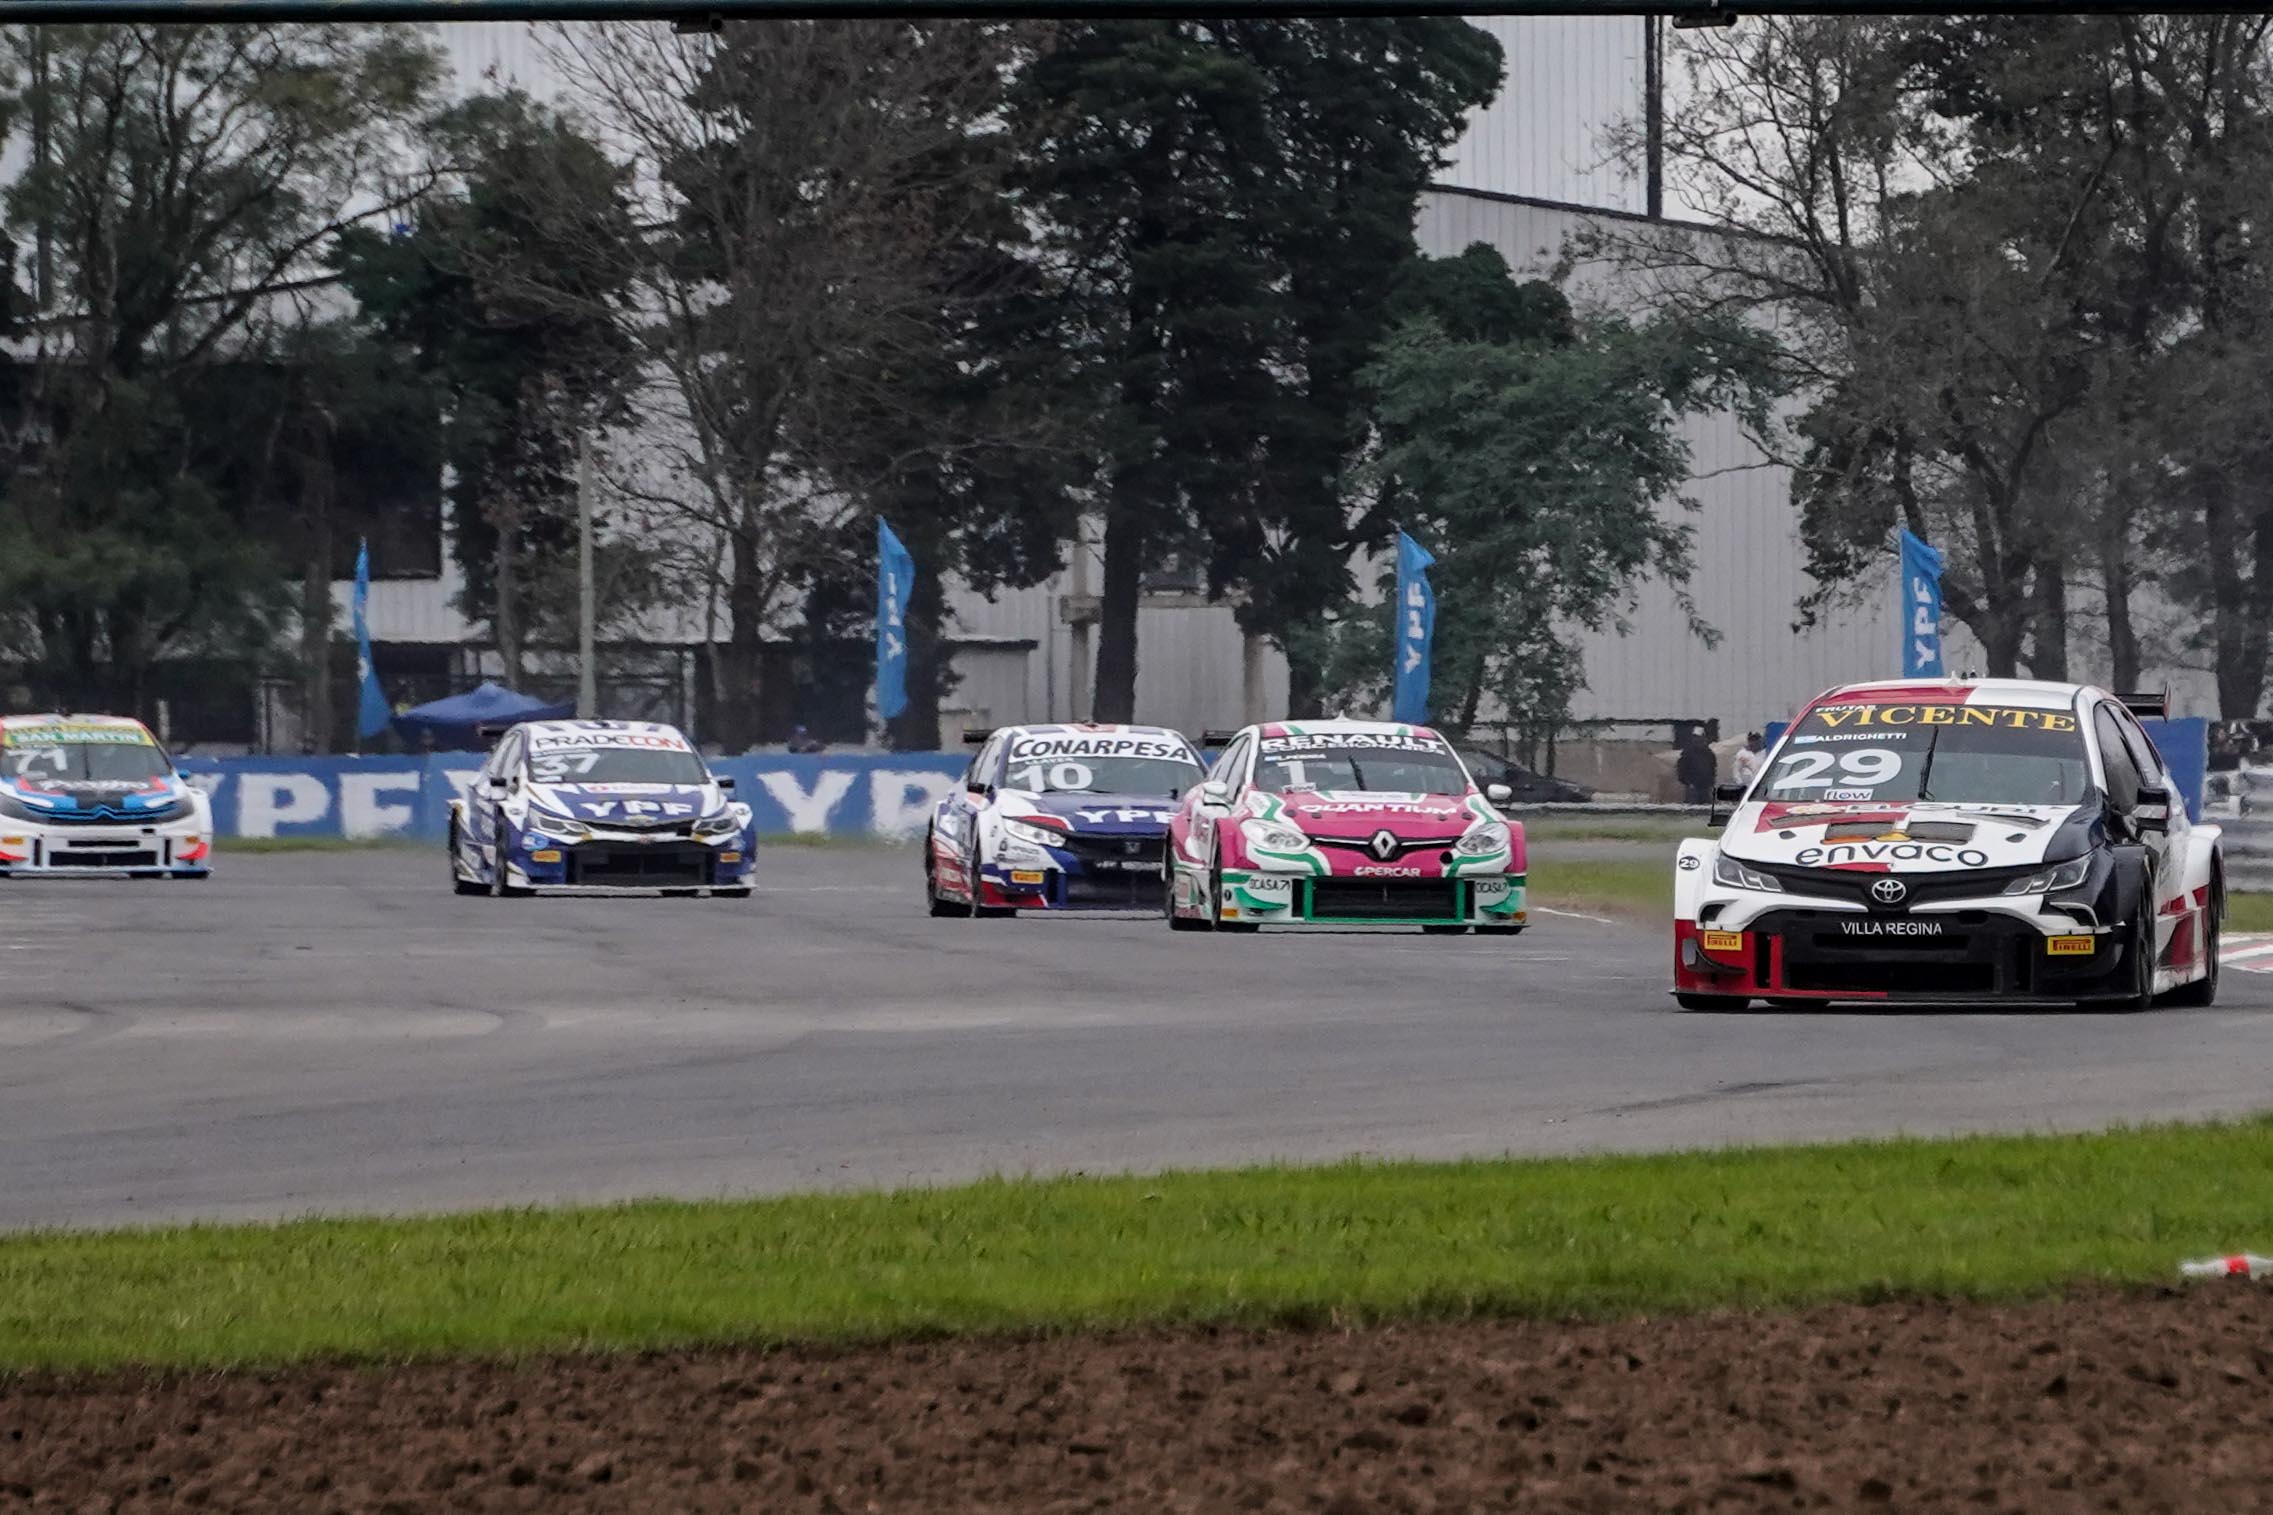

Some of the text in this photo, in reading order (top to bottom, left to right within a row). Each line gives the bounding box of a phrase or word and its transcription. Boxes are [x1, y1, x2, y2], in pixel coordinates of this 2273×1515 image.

[1404, 582, 1425, 674] YPF
[1914, 577, 1936, 670] YPF
[1817, 707, 2075, 731] VICENTE
[1261, 733, 1443, 750] RENAULT
[1816, 732, 1907, 742] ALDRIGHETTI
[1013, 739, 1189, 760] CONARPESA
[531, 752, 600, 776] 37
[1276, 760, 1306, 785] 1
[1773, 749, 1903, 790] 29
[1012, 763, 1093, 793] 10
[1826, 790, 1871, 799] flow
[580, 800, 694, 818] YPF
[1298, 802, 1457, 814] QUANTIUM
[1680, 859, 1699, 868] 29
[1796, 843, 1989, 867] envaco
[1841, 922, 1943, 935] VILLA REGINA
